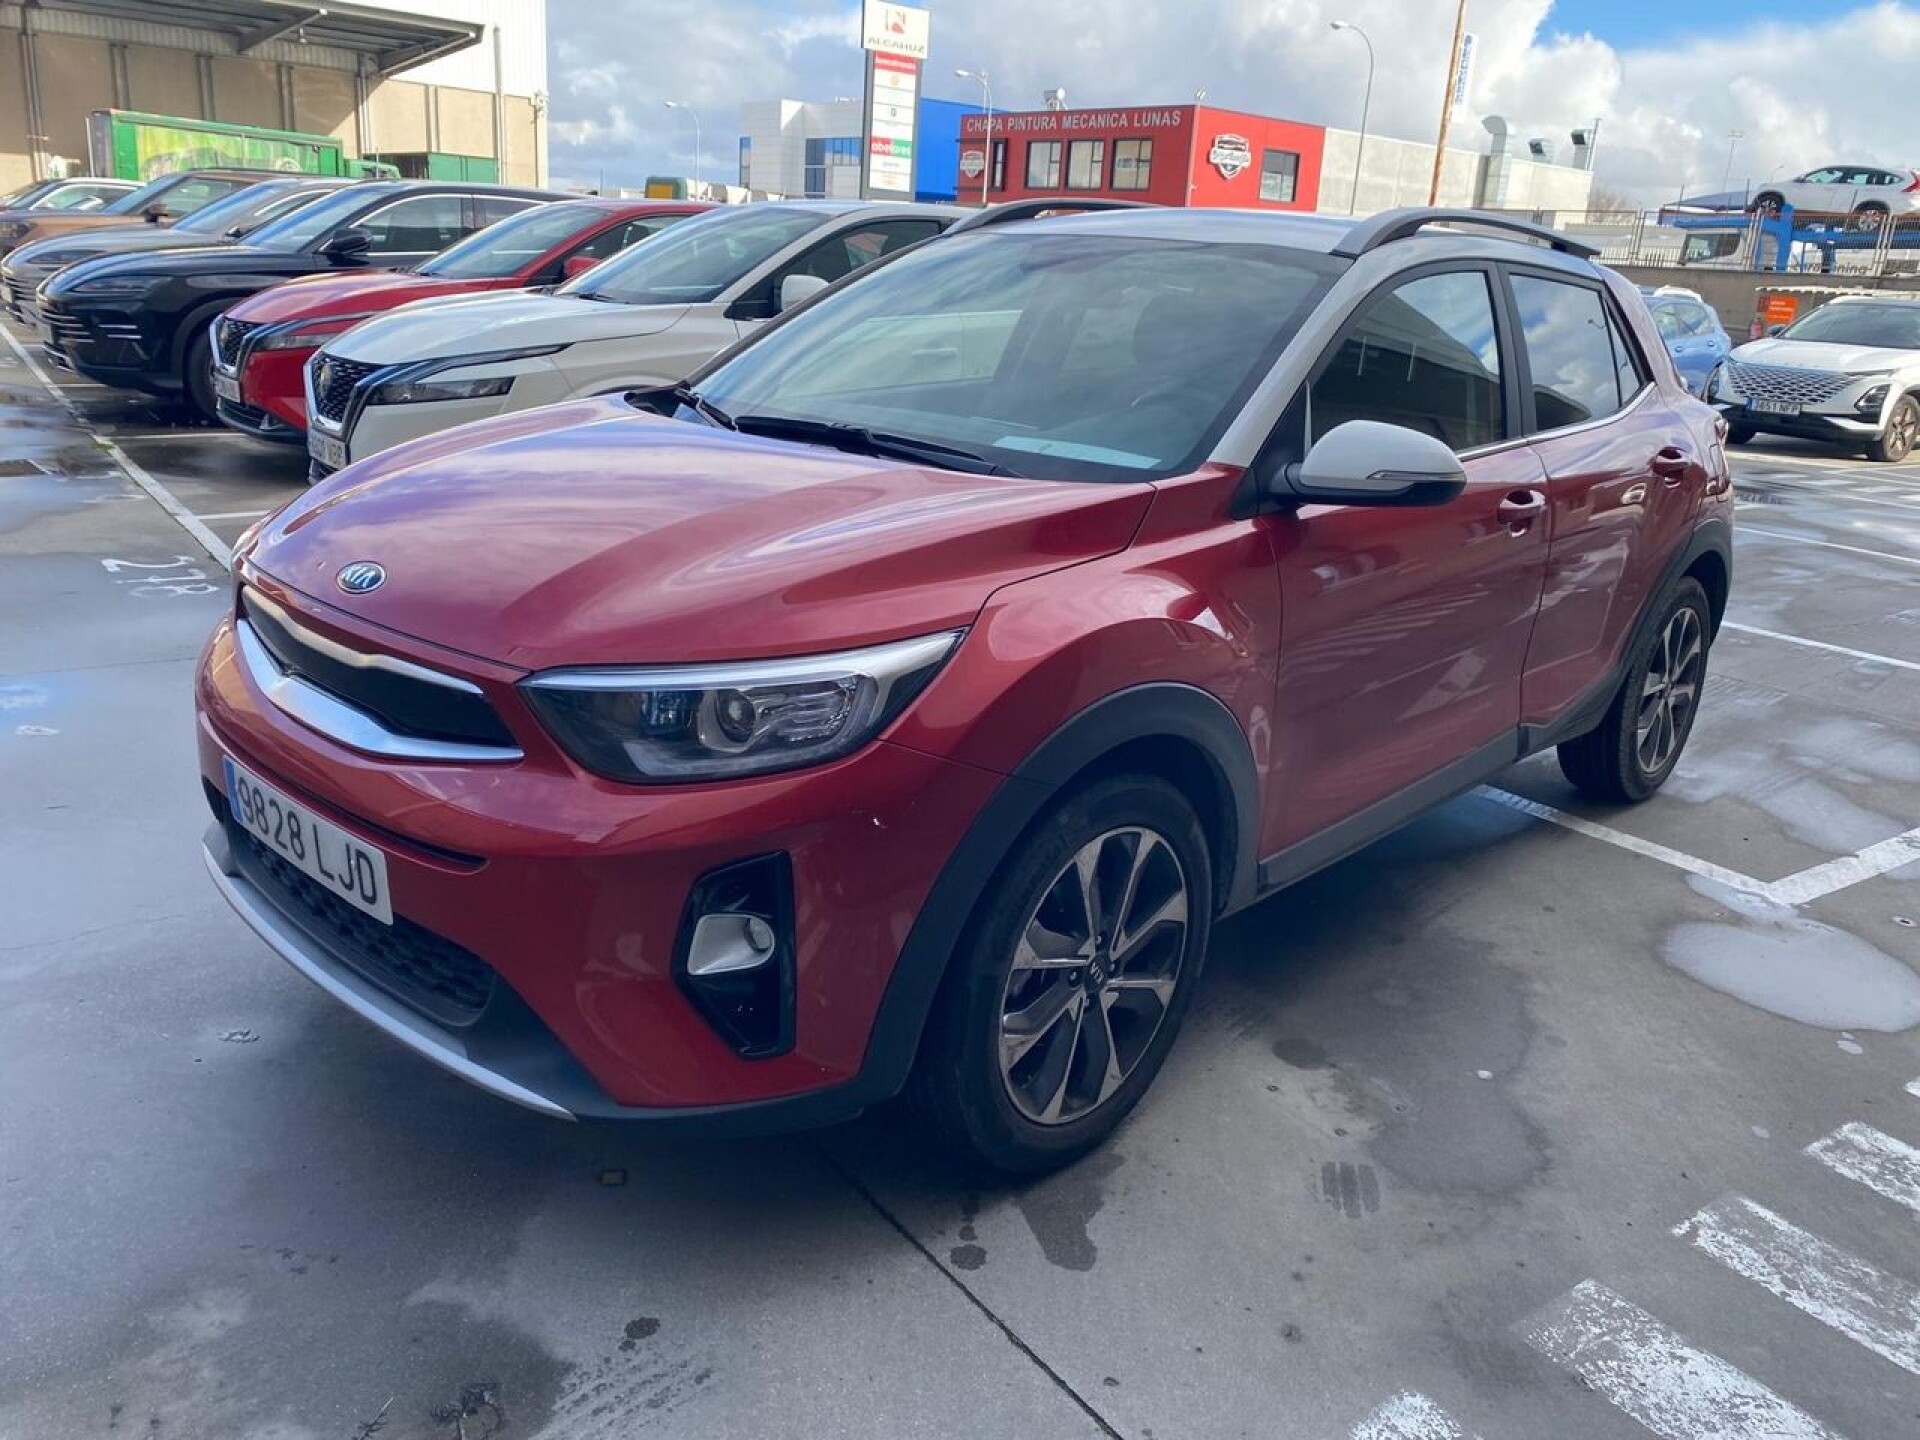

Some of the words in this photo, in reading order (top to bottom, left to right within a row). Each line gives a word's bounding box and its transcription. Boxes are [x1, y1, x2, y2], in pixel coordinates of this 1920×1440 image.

[966, 117, 1003, 132] CHAPA
[1007, 116, 1057, 131] PINTURA
[1061, 113, 1129, 130] MECANICA
[1133, 110, 1182, 127] LUNAS
[237, 776, 306, 861] 9828
[311, 823, 378, 906] LJD
